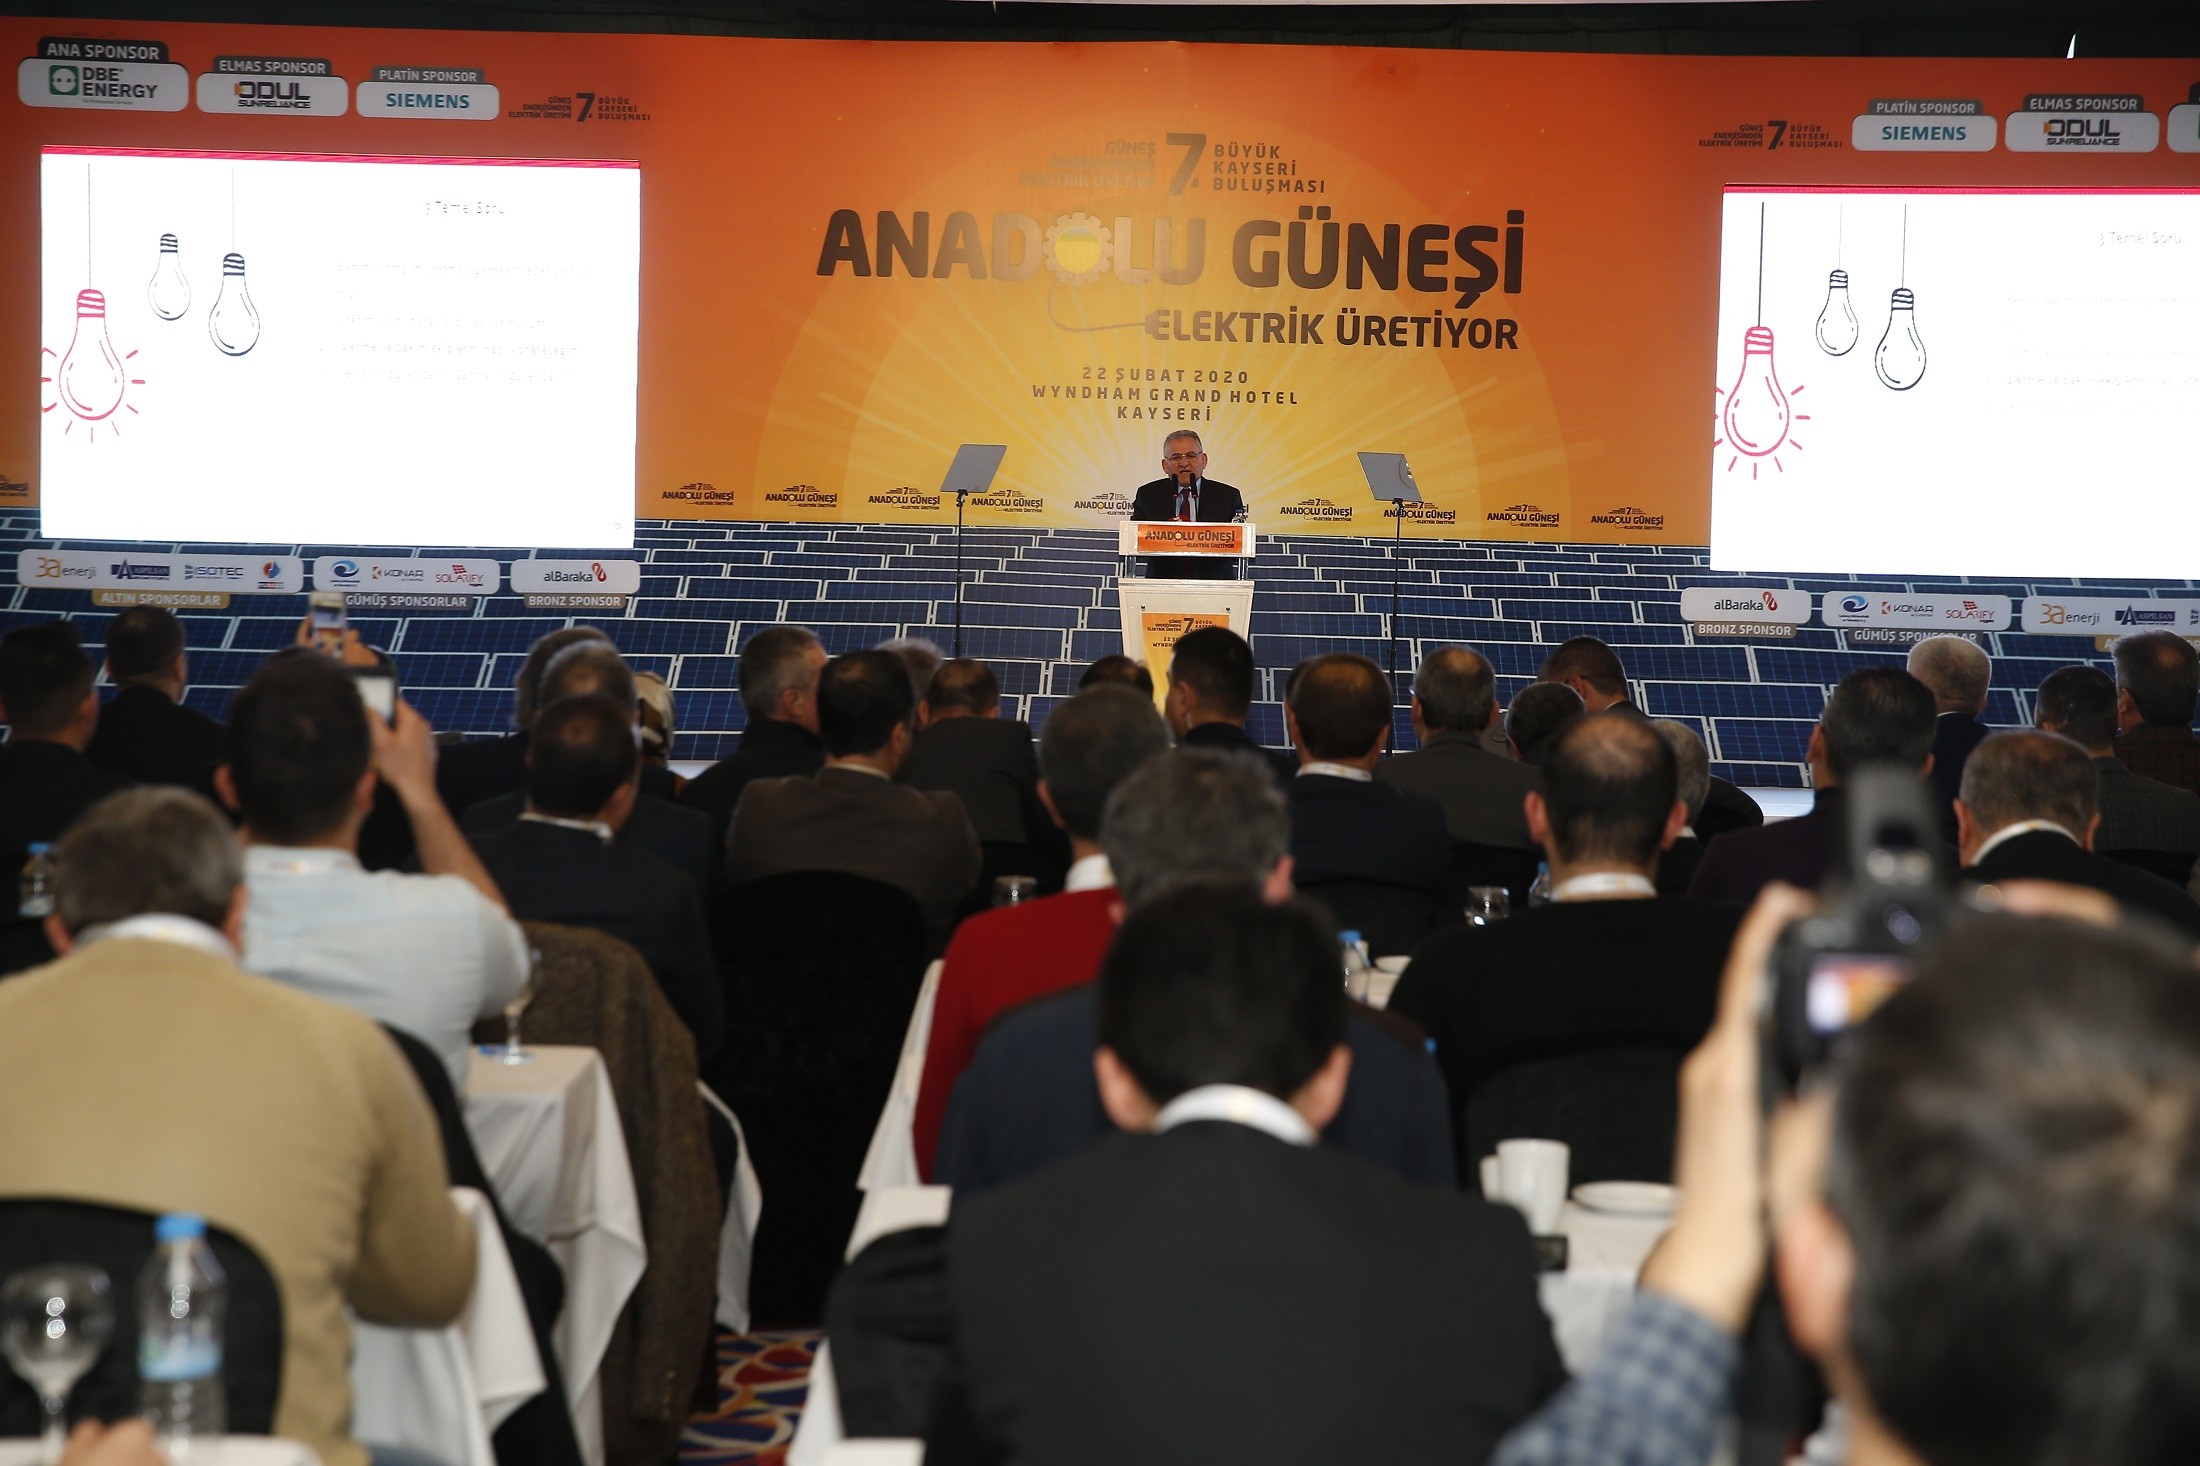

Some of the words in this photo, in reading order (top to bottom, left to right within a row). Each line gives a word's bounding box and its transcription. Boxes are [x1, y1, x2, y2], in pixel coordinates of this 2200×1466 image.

[47, 43, 81, 57] ANA
[85, 45, 160, 60] SPONSOR
[219, 60, 262, 72] ELMAS
[265, 61, 326, 75] SPONSOR
[379, 69, 419, 81] PLATİN
[423, 71, 477, 83] SPONSOR
[83, 82, 158, 98] ENERGY
[238, 81, 311, 100] ODUL
[238, 100, 311, 109] SUNRELIANCE
[386, 92, 470, 109] SIEMENS
[598, 97, 630, 105] BÜYÜK
[2030, 98, 2072, 110] ELMAS
[2076, 99, 2138, 111] SPONSOR
[598, 105, 638, 113] KAYSERİ
[1876, 101, 1914, 114] PLATİN
[1920, 102, 1975, 114] SPONSOR
[598, 112, 650, 121] BULUŞMASI
[1882, 126, 1967, 141] SIEMENS
[2045, 119, 2121, 137] ODUL
[1790, 132, 1829, 140] KAYSERİ
[2046, 138, 2120, 146] SUNRELIANCE
[1214, 142, 1280, 159] BÜYÜK
[1790, 141, 1842, 149] BULUŞMASI
[1213, 159, 1297, 176] KAYSERİ
[1213, 178, 1326, 194] BULUŞMASI
[816, 208, 1206, 287] ANADOLU
[1232, 205, 1524, 309] GÜNEŞİ
[1152, 306, 1325, 345] ELEKTRİK
[1336, 307, 1518, 350] ÜRETİYOR
[1082, 367, 1107, 380] 22
[1116, 368, 1185, 383] ŞUBAT
[1194, 370, 1248, 384] 2020
[1033, 385, 1141, 400] WYNDHAM
[1149, 388, 1221, 402] GRAND
[1230, 390, 1298, 405] HOTEL
[1117, 406, 1211, 421] KAYSERİ
[662, 491, 702, 500] ANADOLU
[704, 491, 734, 501] GÜNEŞİ
[765, 493, 805, 502] ANADOLU
[807, 493, 837, 503] GÜNEŞİ
[868, 496, 908, 504] ANADOLU
[910, 495, 940, 506] GÜNEŞİ
[971, 498, 1011, 506] ANADOLU
[1013, 498, 1043, 508] GÜNEŞİ
[1074, 501, 1114, 509] ANADOLU
[1116, 501, 1134, 510] GÜN
[1280, 507, 1320, 516] ANADOLU
[1322, 506, 1352, 517] GÜNEŞİ
[1426, 509, 1456, 520] GÜNEŞİ
[1487, 512, 1527, 521] ANADOLU
[1529, 512, 1560, 523] GÜNEŞİ
[1591, 515, 1631, 525] ANADOLU
[1633, 515, 1663, 526] GÜNEŞİ
[1145, 530, 1195, 540] ANADOLU
[1198, 530, 1235, 543] GÜNEŞİ
[62, 566, 97, 579] enerji
[384, 569, 424, 577] KONAR
[436, 574, 484, 583] SOLARIFY
[544, 571, 593, 582] alBaraka
[102, 593, 136, 604] ALTIN
[139, 594, 221, 606] SPONSORLAR
[346, 593, 387, 608] GÜMÜŞ
[390, 595, 467, 607] SPONSORLAR
[529, 596, 567, 606] BRONZ
[571, 597, 621, 607] SPONSOR
[1714, 600, 1763, 611] alBaraka
[1893, 604, 1934, 613] KONAR
[1945, 609, 1995, 619] SOLARIFY
[2065, 613, 2100, 626] enerji
[1698, 624, 1736, 634] BRONZ
[1739, 625, 1791, 636] SPONSOR
[1854, 628, 1896, 643] GÜMÜŞ
